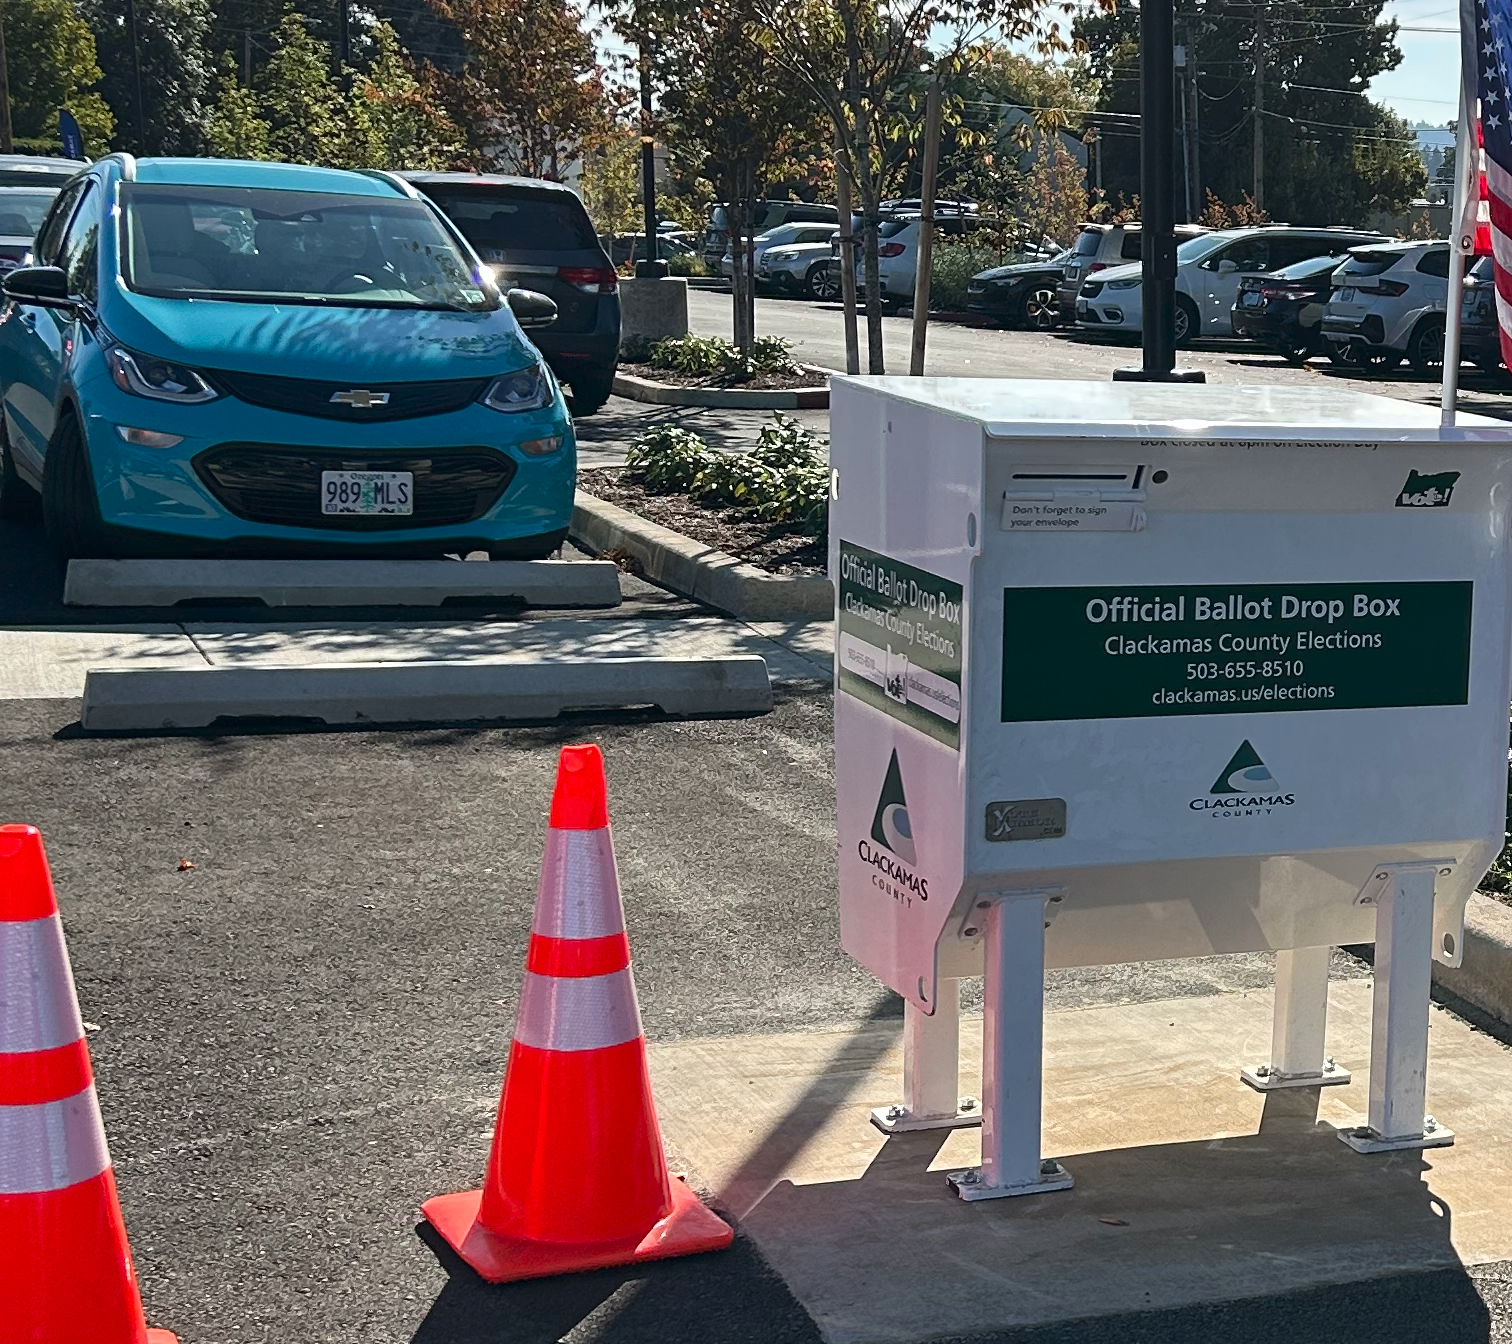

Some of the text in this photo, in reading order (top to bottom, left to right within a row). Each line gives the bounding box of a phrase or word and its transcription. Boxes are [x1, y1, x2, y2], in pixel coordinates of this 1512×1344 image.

[326, 481, 409, 505] 989 MLS
[1010, 518, 1080, 528] your envelope
[1013, 506, 1107, 516] Don't forget to sign
[842, 553, 961, 626] Official Ballot Drop Box
[1086, 594, 1401, 623] Official Ballot Drop Box
[886, 609, 915, 645] County
[916, 622, 955, 659] Elections
[1104, 630, 1382, 655] Clackamas County Elections
[1186, 660, 1304, 680] 503-655-8510
[1152, 683, 1336, 705] clackamas.us/elections
[1188, 794, 1296, 810] CLACKAMAS
[1211, 808, 1273, 818] COUNTY
[858, 839, 929, 901] CLACKAMAS
[872, 874, 913, 909] COUNTY
